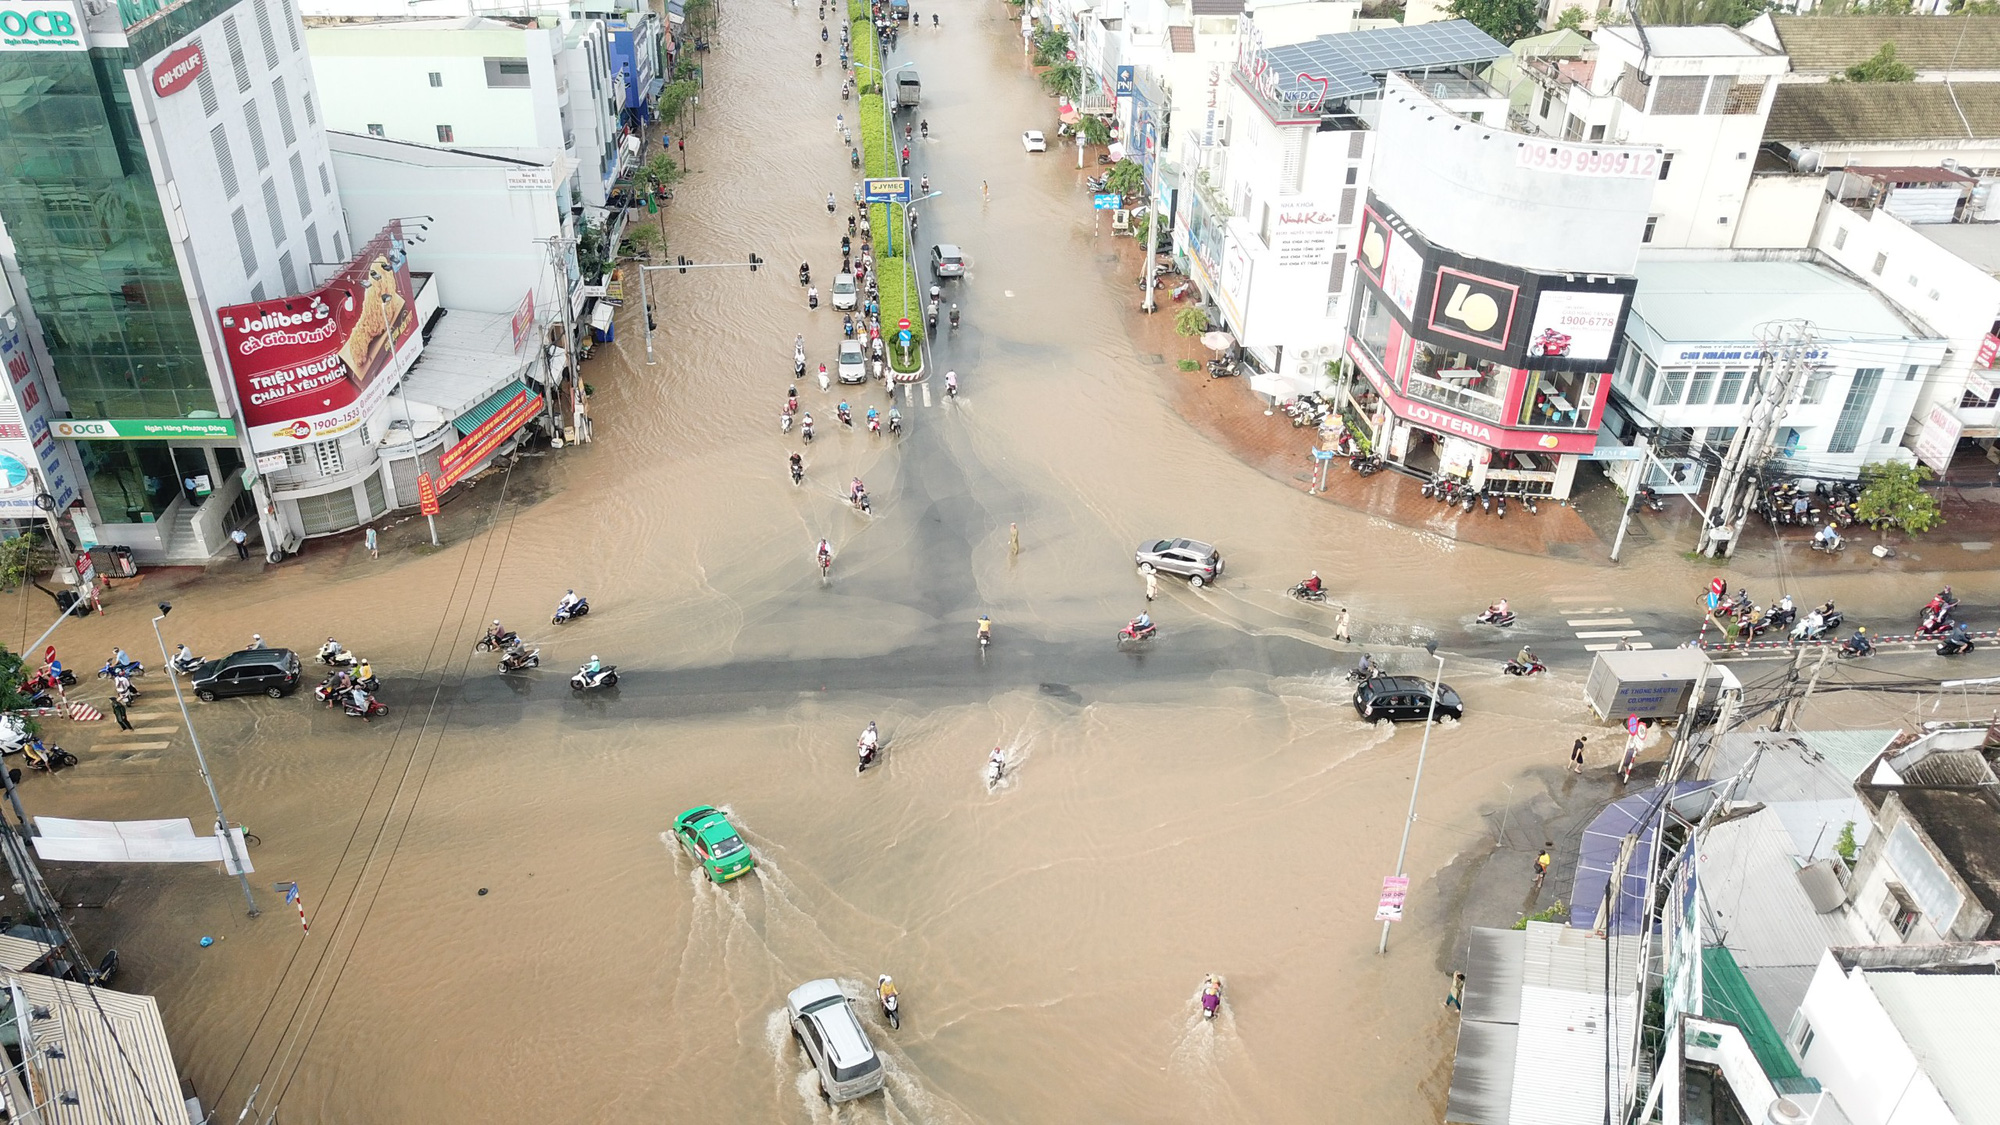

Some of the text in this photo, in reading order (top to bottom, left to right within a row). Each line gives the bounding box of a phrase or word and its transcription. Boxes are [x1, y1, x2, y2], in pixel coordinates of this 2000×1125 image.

[0, 10, 75, 36] OCB
[186, 52, 202, 70] LIFE
[1118, 81, 1132, 90] PNJ
[1522, 144, 1572, 170] 0939
[239, 310, 314, 334] Jollibee
[1560, 316, 1614, 326] 1900-6778
[240, 336, 262, 356] Gà
[262, 328, 299, 348] Giòn
[298, 328, 326, 344] Vui
[1702, 350, 1742, 359] NHÁNH
[250, 354, 342, 390] TRIỆU NGƯỜI
[250, 362, 348, 406] CHÂU Á YÊU THÍCH
[29, 415, 47, 438] 151
[74, 424, 105, 434] OCB
[163, 424, 181, 433] Hàng
[208, 425, 227, 434] Đông
[313, 408, 360, 430] 1900-1533
[1407, 404, 1491, 441] LOTTERIA
